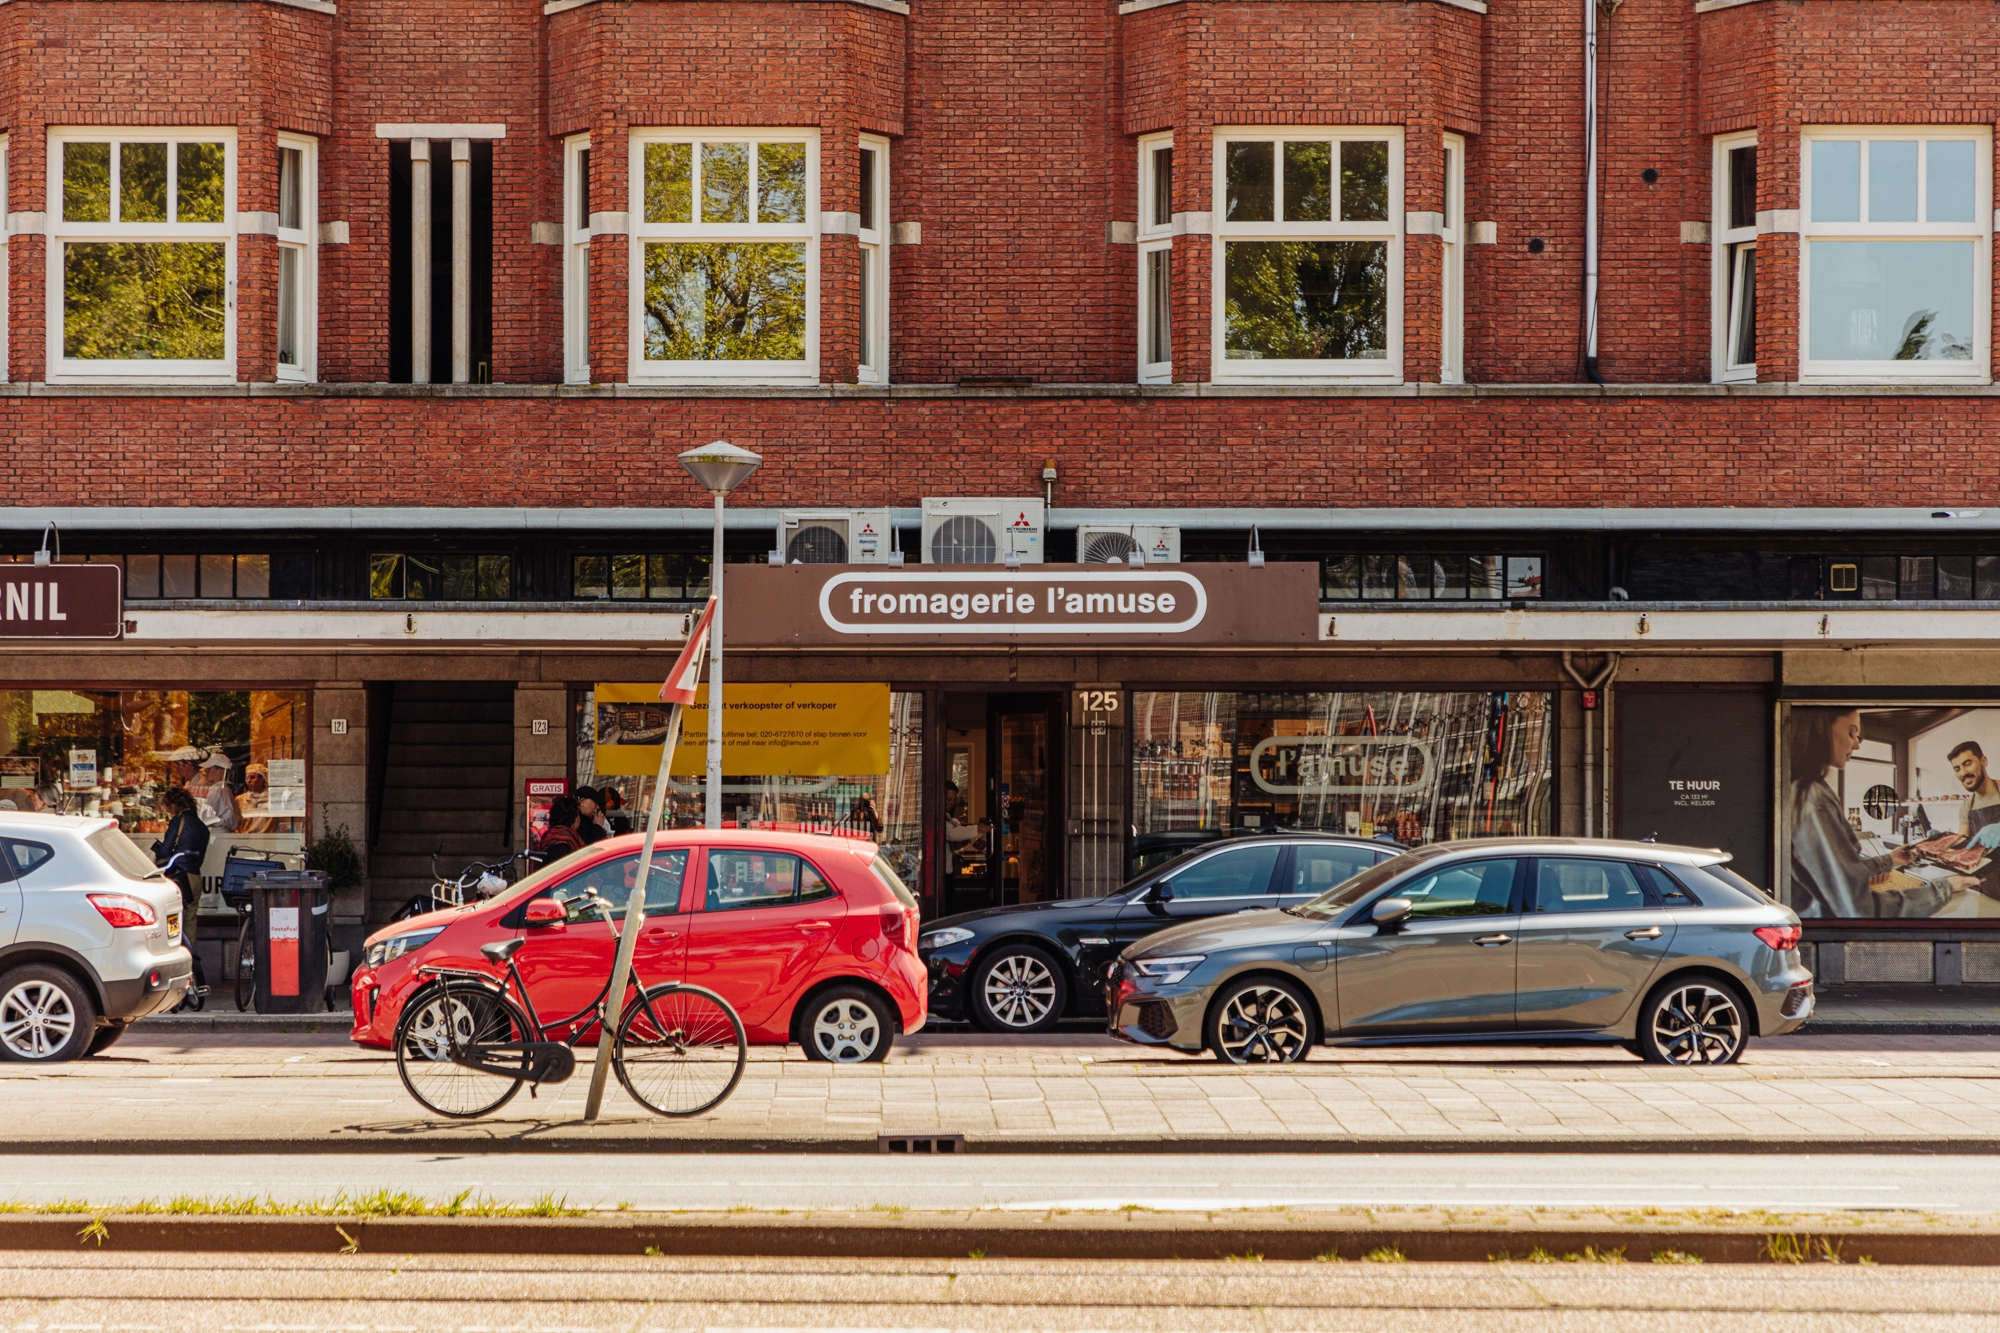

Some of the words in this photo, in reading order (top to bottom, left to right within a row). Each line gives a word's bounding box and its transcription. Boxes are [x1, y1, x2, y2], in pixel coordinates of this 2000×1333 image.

[0, 582, 67, 620] NIL
[849, 587, 1035, 620] fromagerie
[1047, 587, 1177, 614] l'amuse
[690, 701, 727, 710] Gezt
[729, 701, 783, 711] verkoopster
[785, 701, 796, 710] of
[796, 701, 837, 711] verkoper
[1079, 691, 1119, 712] 125
[333, 720, 344, 732] 121
[534, 721, 547, 733] 123
[746, 730, 759, 738] bel:
[760, 730, 804, 738] 020-6727670
[804, 730, 813, 738] of
[813, 730, 828, 739] stap
[829, 730, 852, 738] binnen
[768, 739, 820, 748] info@lamuse.nl
[1279, 749, 1410, 778] l'amuse
[532, 784, 562, 792] GRATIS
[1668, 780, 1684, 790] TE
[1687, 780, 1721, 790] HUUR
